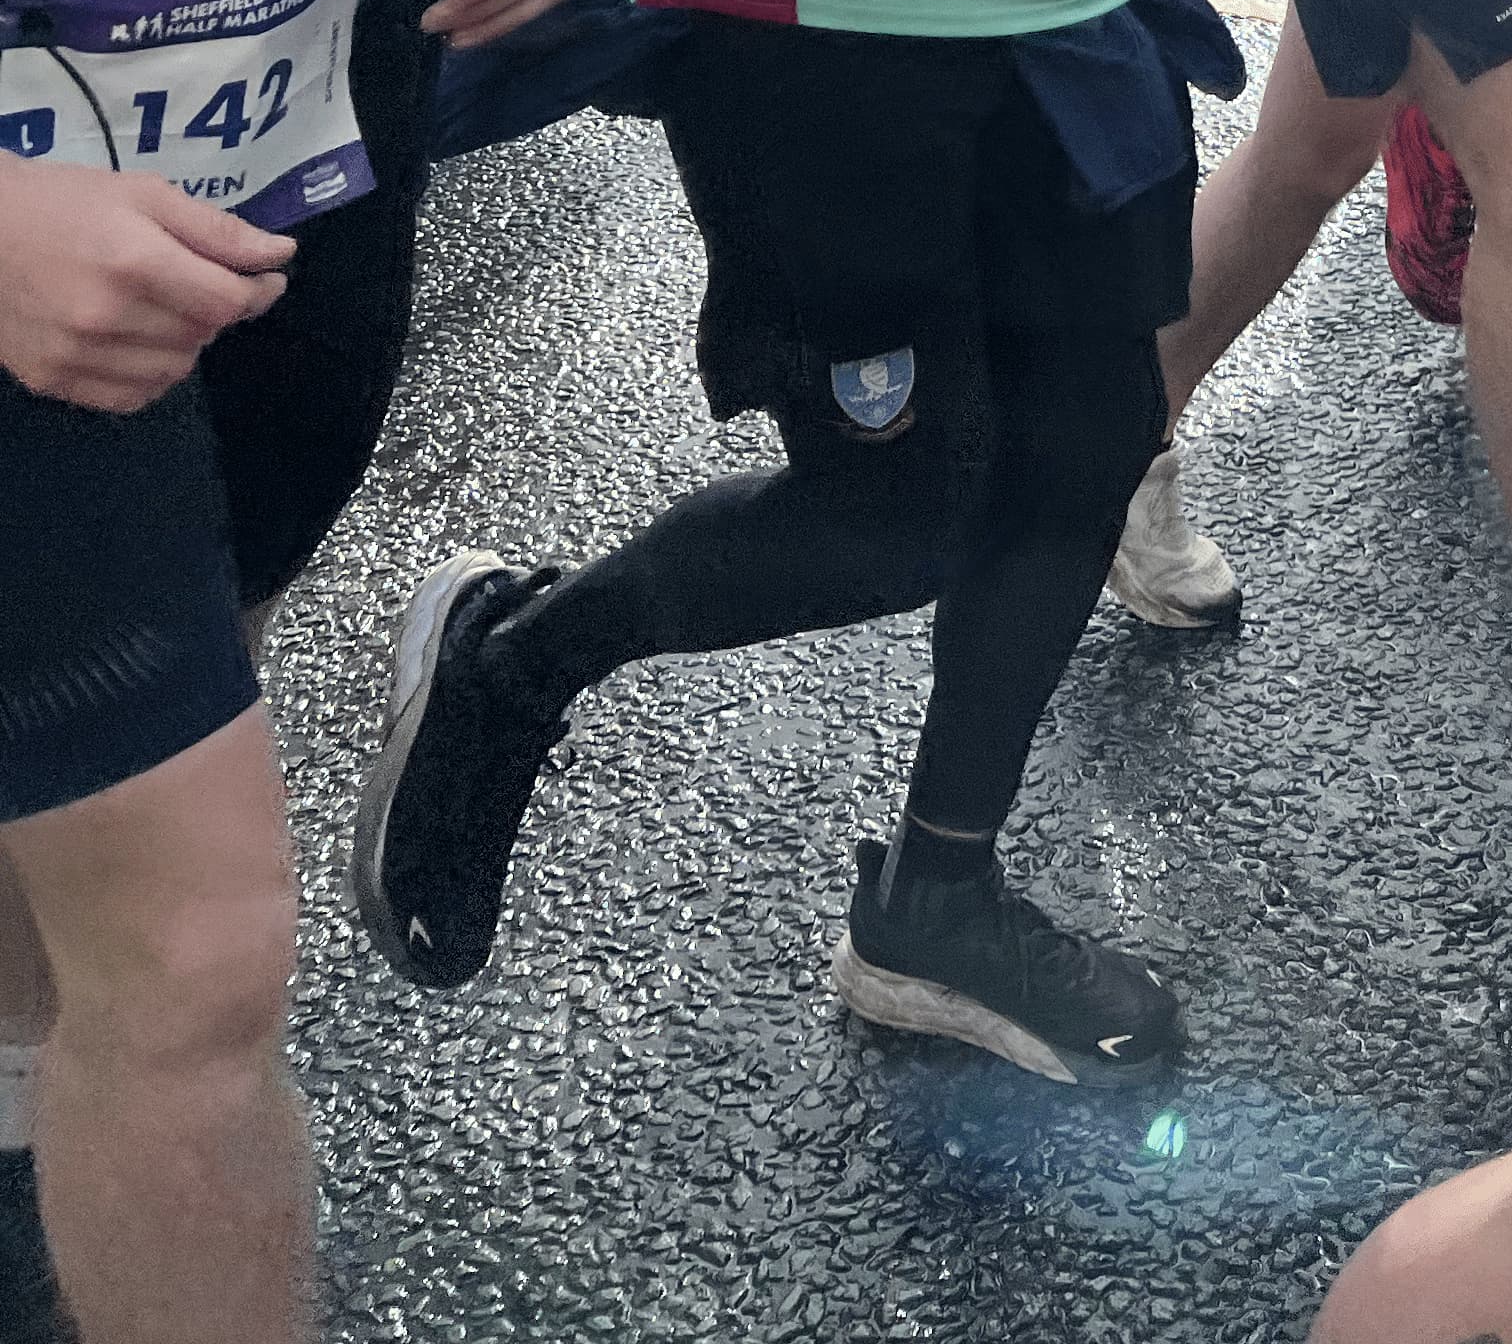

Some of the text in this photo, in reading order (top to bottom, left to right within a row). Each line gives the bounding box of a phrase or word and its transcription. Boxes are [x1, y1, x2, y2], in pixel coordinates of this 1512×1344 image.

[166, 18, 218, 37] HALF
[133, 59, 293, 155] 142
[168, 171, 247, 199] VEN
